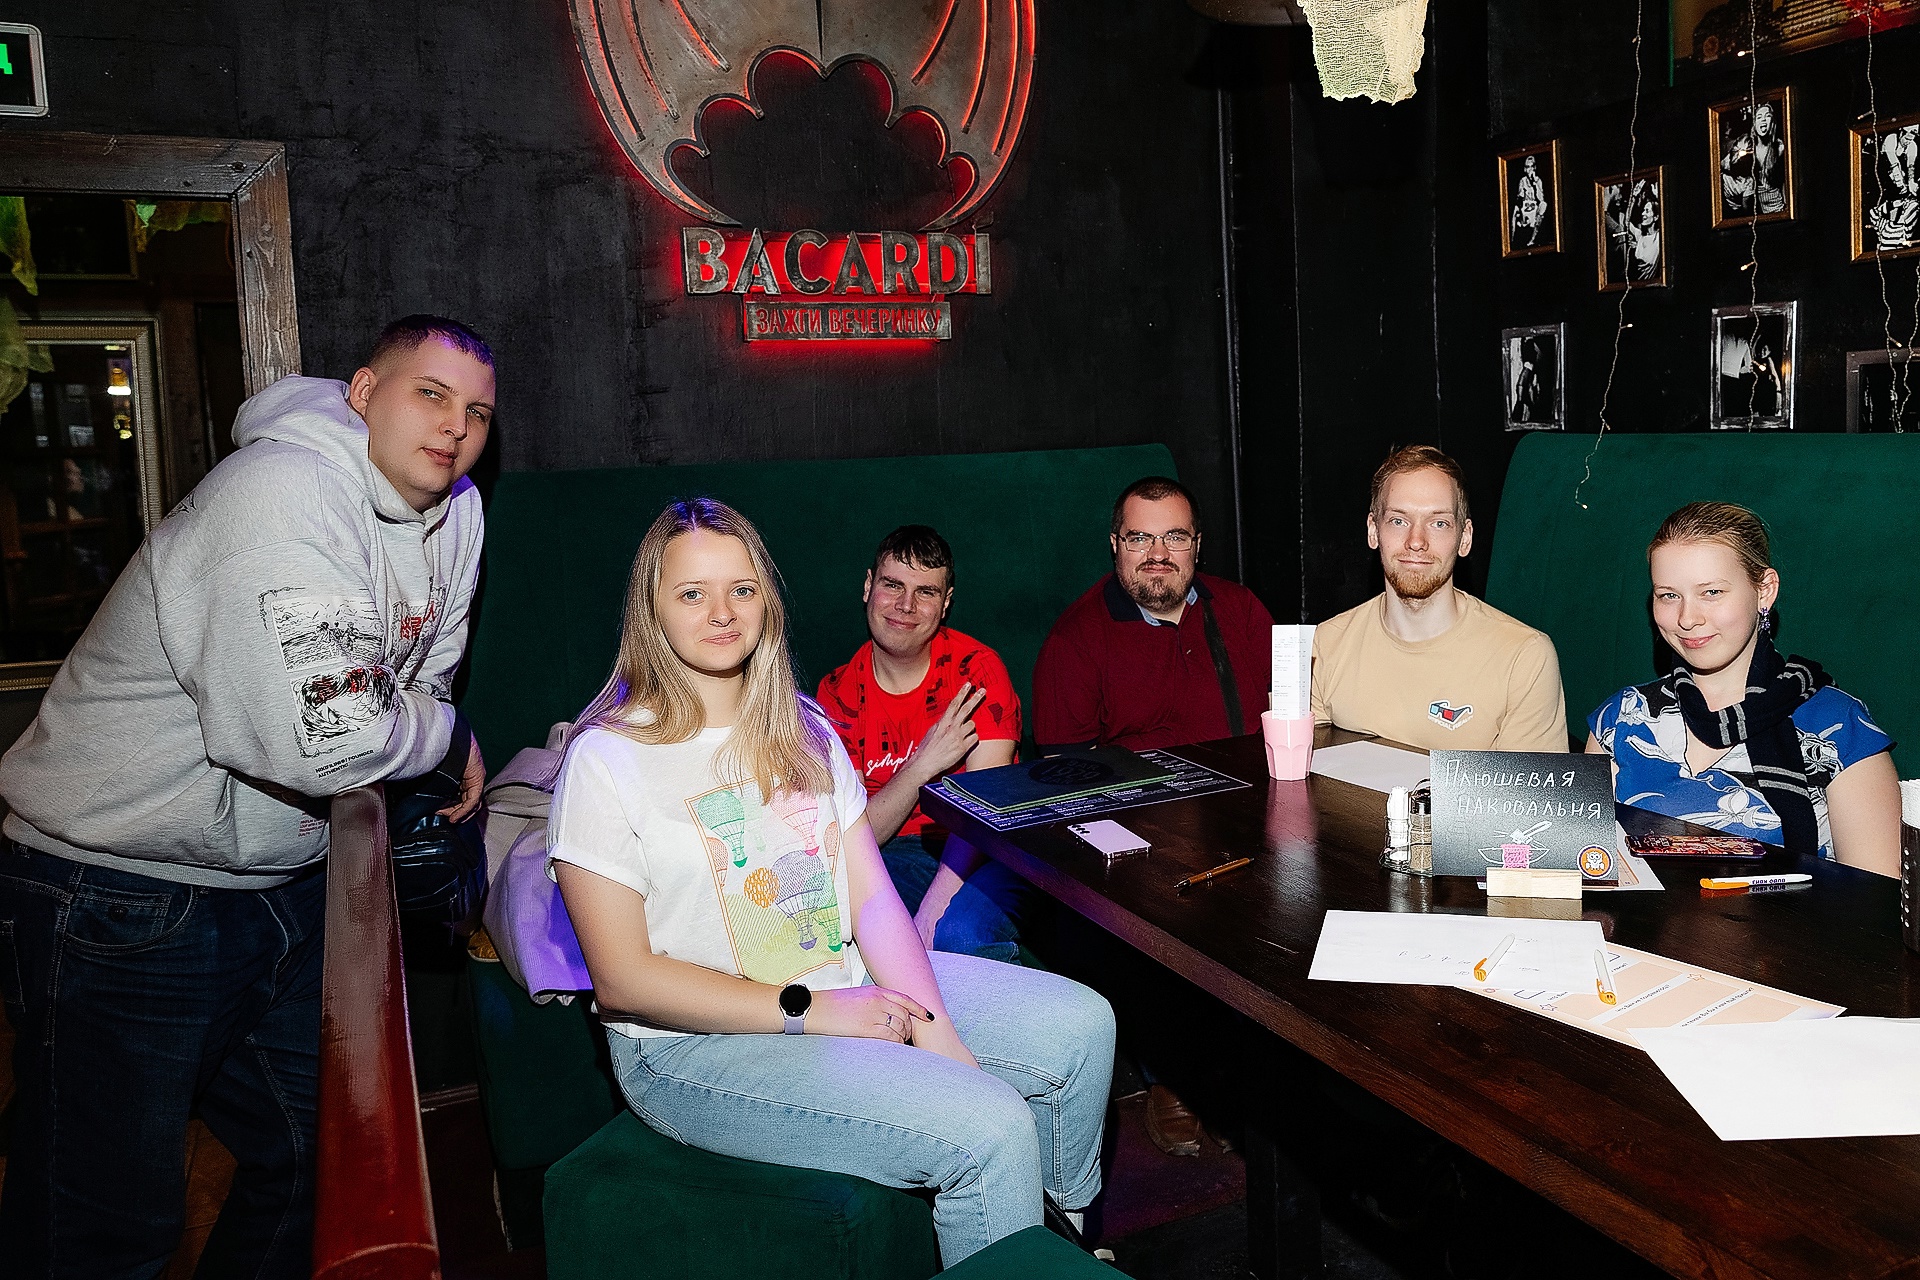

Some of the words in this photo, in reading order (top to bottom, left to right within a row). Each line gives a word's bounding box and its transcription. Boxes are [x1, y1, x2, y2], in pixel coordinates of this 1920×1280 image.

[683, 227, 992, 295] BACARDI
[756, 308, 822, 334] ЗАЖГИ
[829, 308, 941, 334] ВЕЧЕРИНКУ
[1457, 798, 1602, 820] НАКОВАЛЬНЯ
